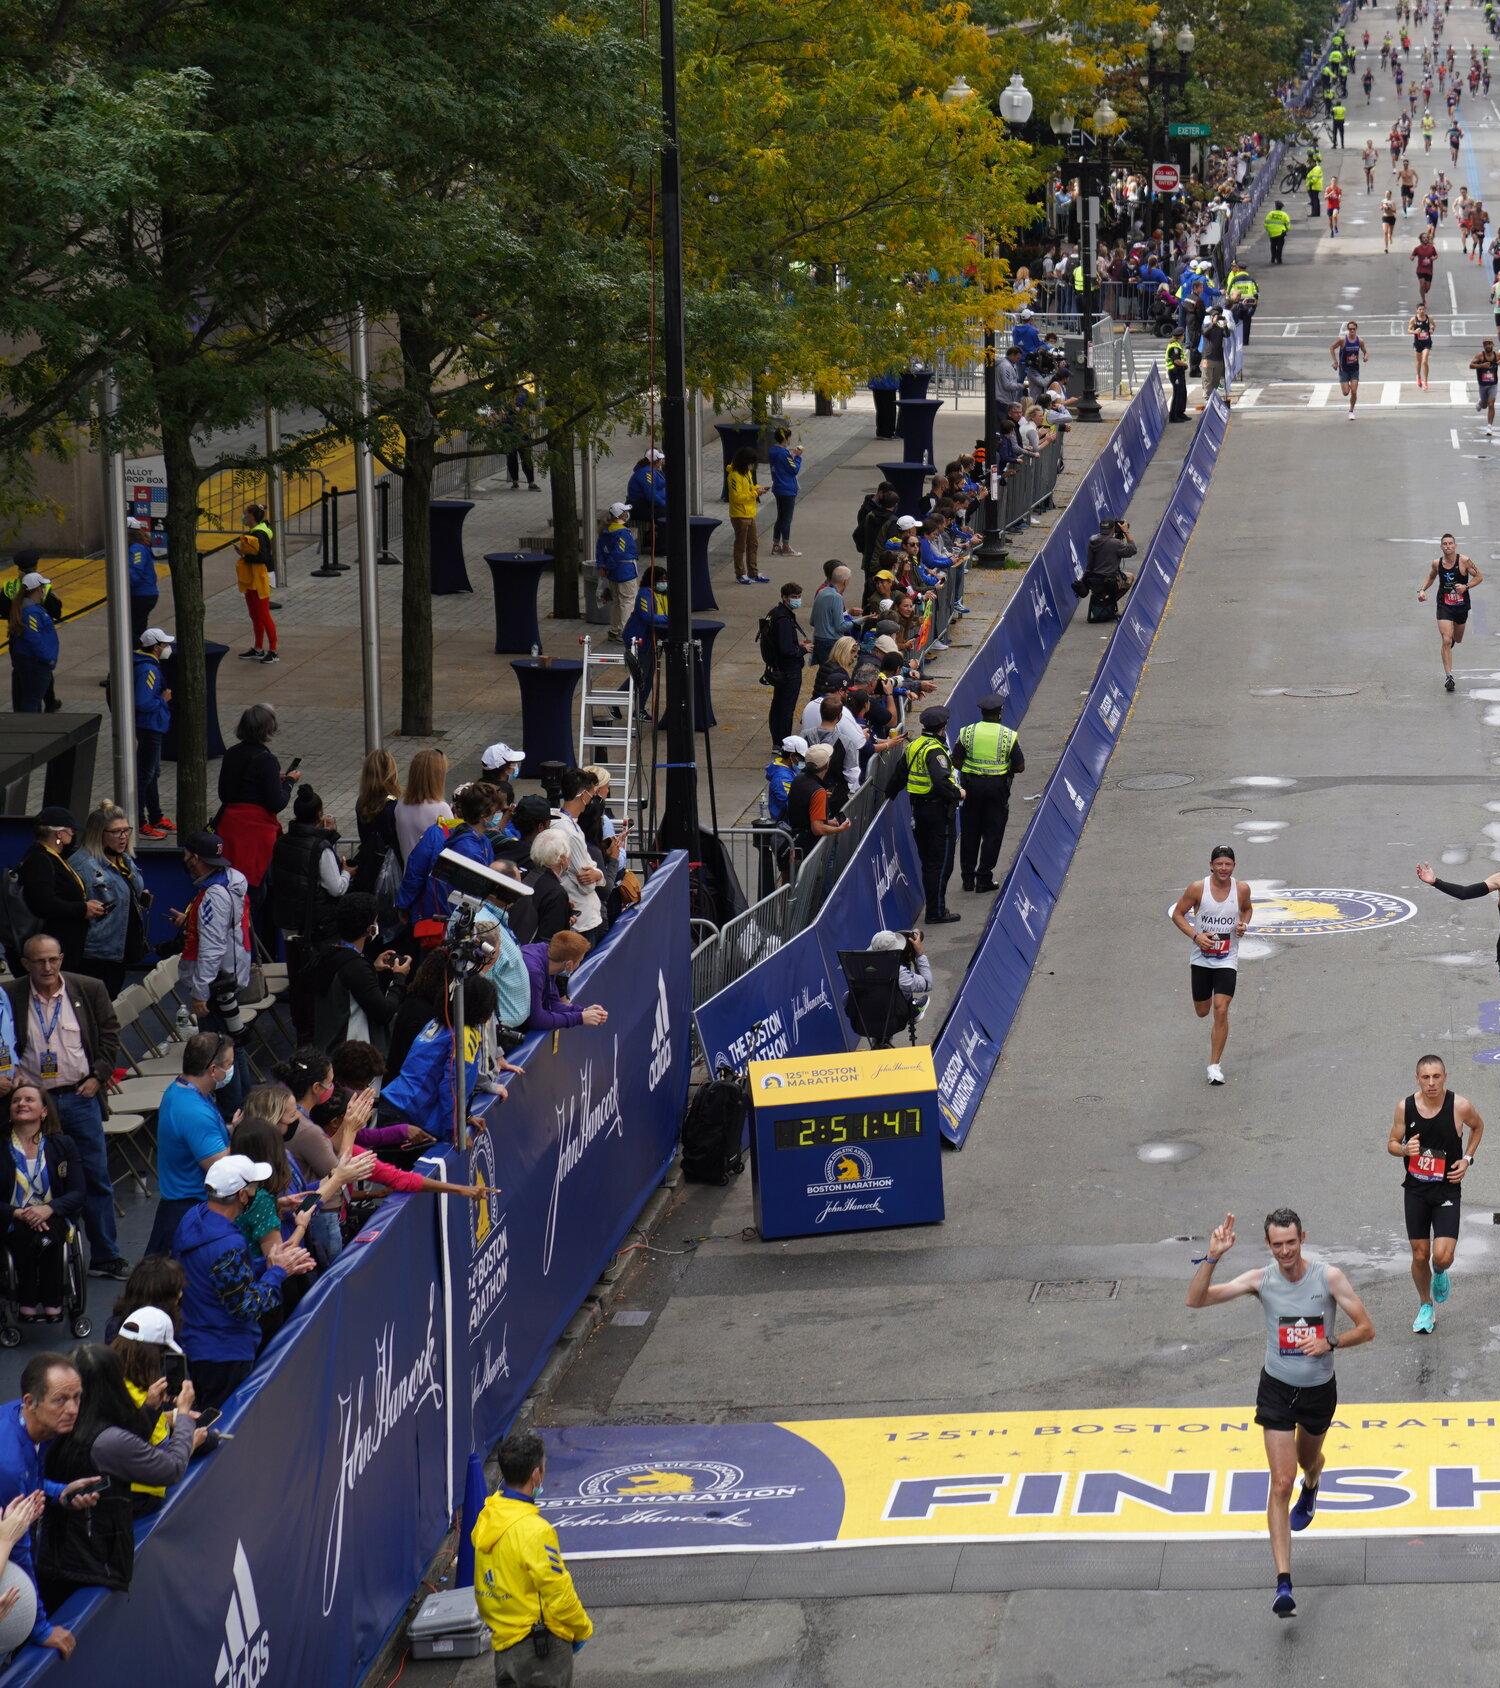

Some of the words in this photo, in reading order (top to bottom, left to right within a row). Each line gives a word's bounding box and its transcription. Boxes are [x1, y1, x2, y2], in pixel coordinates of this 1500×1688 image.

[1177, 126, 1200, 135] EXETER
[124, 468, 153, 476] ALLOT
[124, 475, 145, 483] ROP
[146, 476, 165, 484] BOX
[727, 1035, 748, 1065] THE
[784, 1070, 809, 1080] 125TH
[811, 1066, 857, 1077] BOSTON
[786, 1074, 859, 1088] MARATHON
[799, 1108, 921, 1146] 2:51:47
[1416, 1156, 1436, 1172] 421
[806, 1183, 843, 1195] BOSTON
[843, 1179, 893, 1190] MARATHON
[841, 1196, 885, 1213] Hancock
[478, 1225, 508, 1280] BOSTON
[469, 1256, 509, 1335] ARATHON
[883, 1427, 1009, 1443] 125TH
[1032, 1422, 1250, 1437] BOSTON
[322, 1375, 377, 1617] John
[370, 1281, 444, 1454] Hancock
[535, 1496, 623, 1509] OSTON
[631, 1487, 800, 1505] MARATHON
